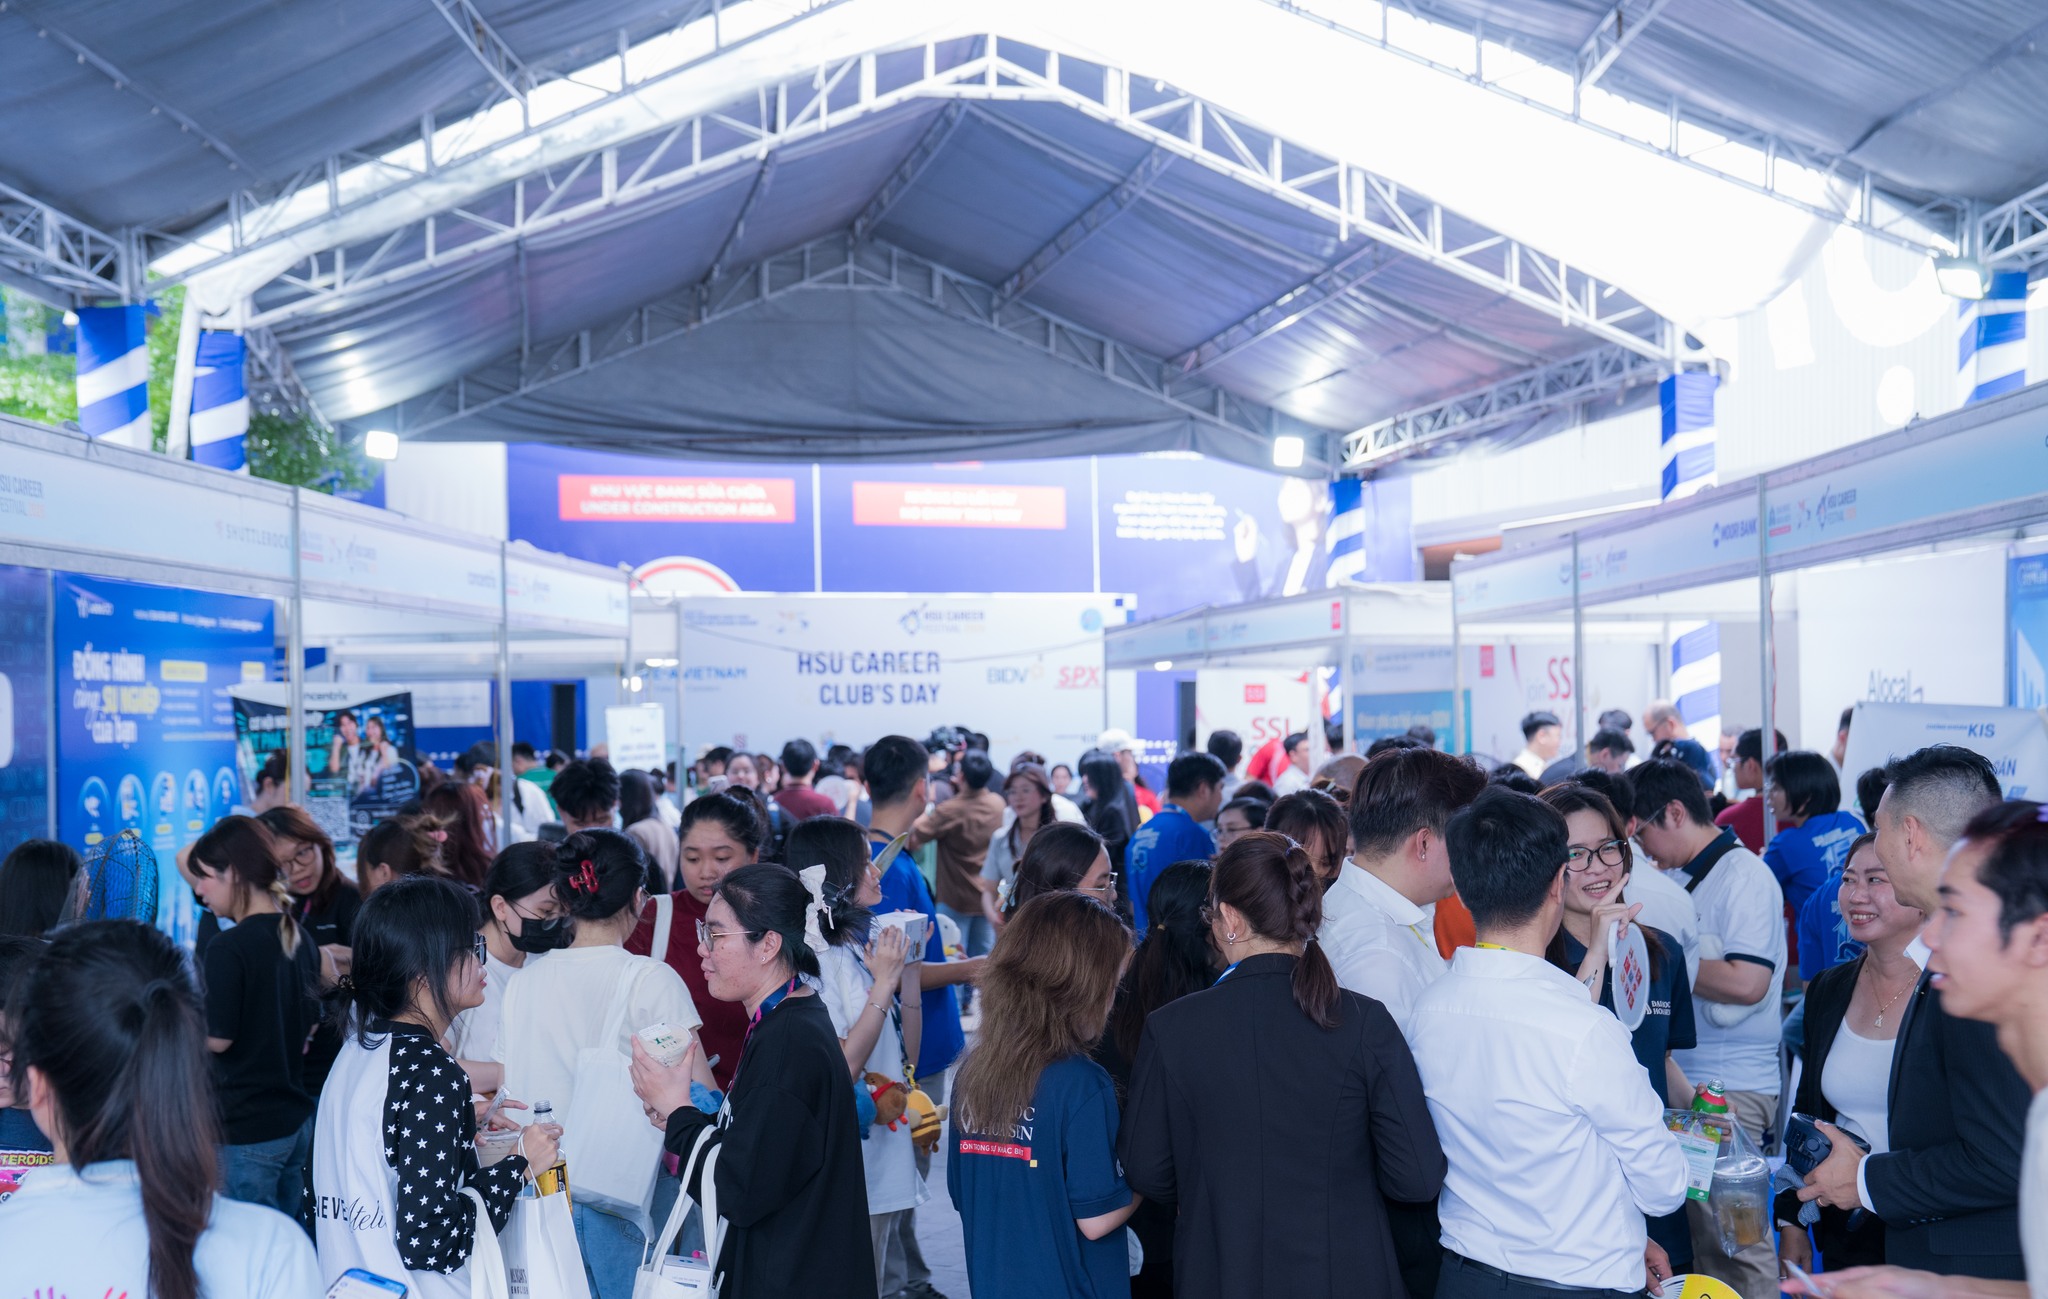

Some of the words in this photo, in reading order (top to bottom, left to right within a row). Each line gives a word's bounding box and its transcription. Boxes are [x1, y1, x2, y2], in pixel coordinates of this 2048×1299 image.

[13, 478, 43, 498] CAREER
[683, 665, 747, 681] VIETNAM
[798, 652, 843, 675] HSU
[852, 652, 940, 675] CAREER
[987, 667, 1028, 684] BIDV
[1058, 666, 1100, 686] SPX
[819, 684, 894, 705] CLUB'S
[901, 684, 940, 705] DAY
[1967, 723, 1996, 739] KIS
